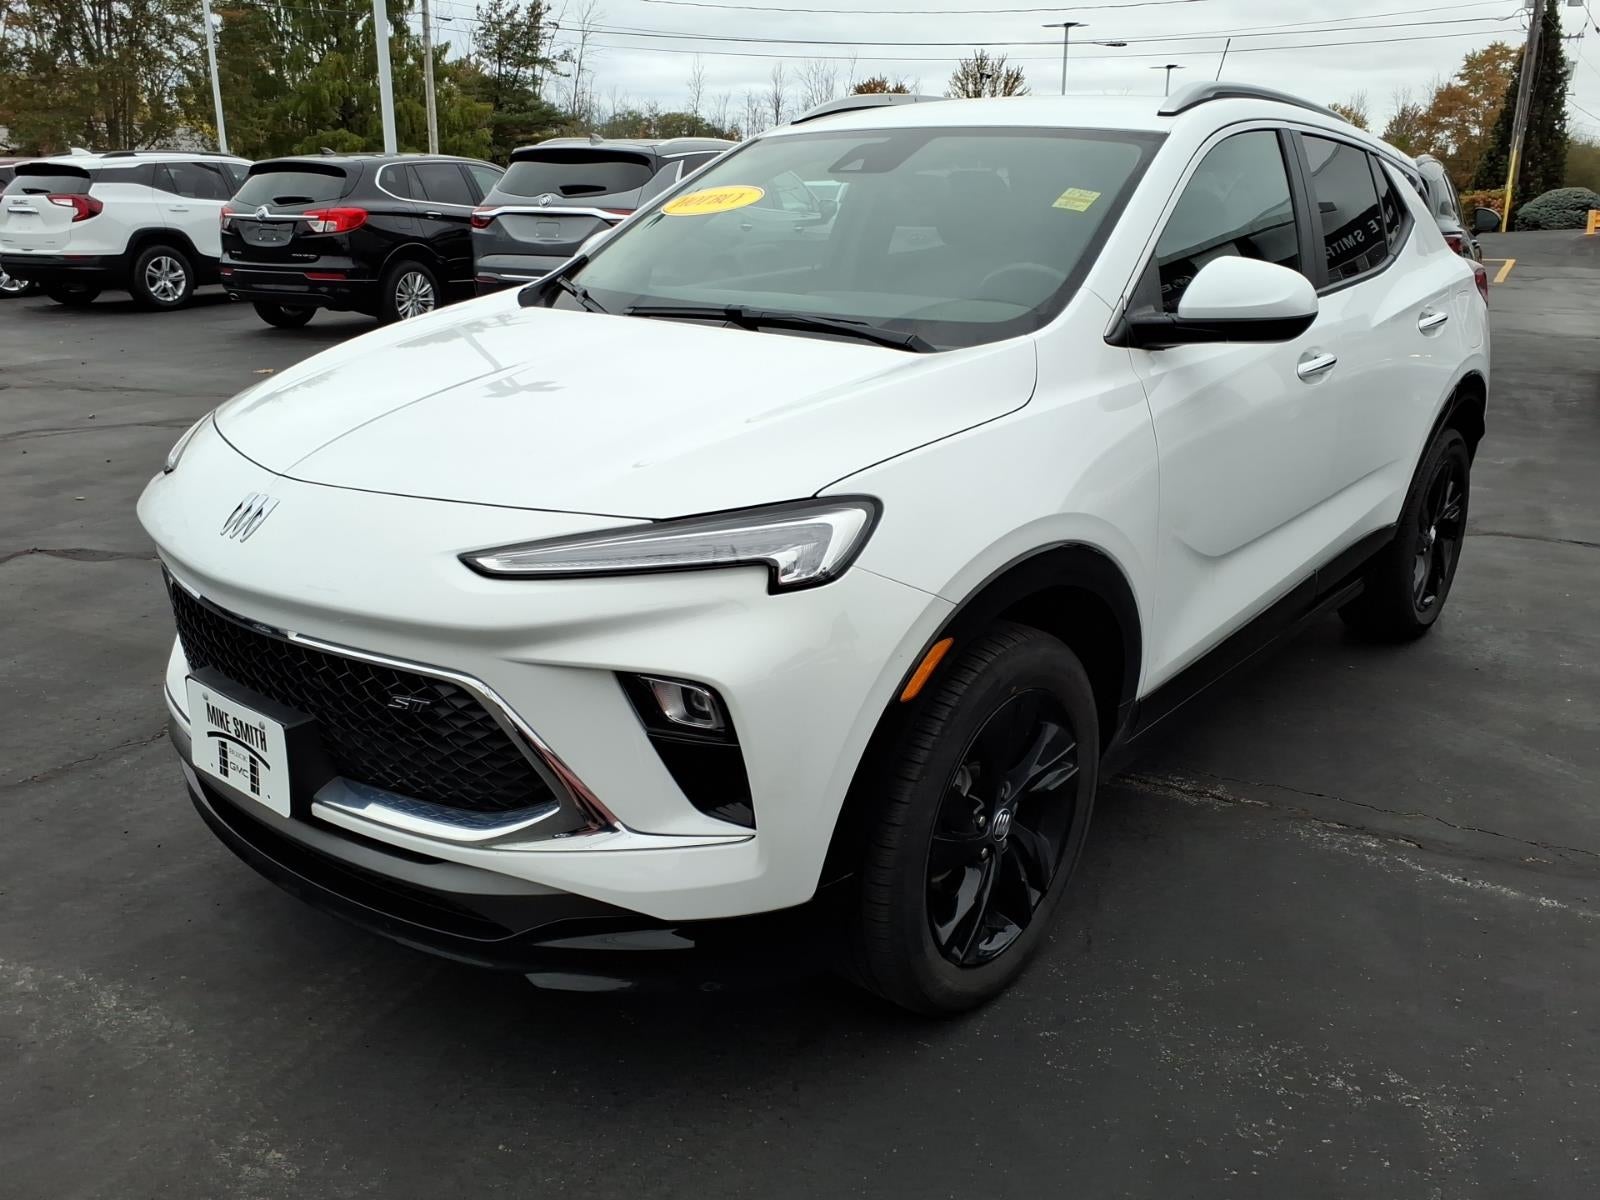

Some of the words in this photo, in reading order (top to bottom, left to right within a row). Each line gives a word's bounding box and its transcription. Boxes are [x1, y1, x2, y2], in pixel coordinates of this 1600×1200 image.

[388, 694, 431, 712] ST
[206, 702, 232, 733] MIKE
[232, 716, 268, 753] SMITH
[229, 761, 249, 779] GMC
